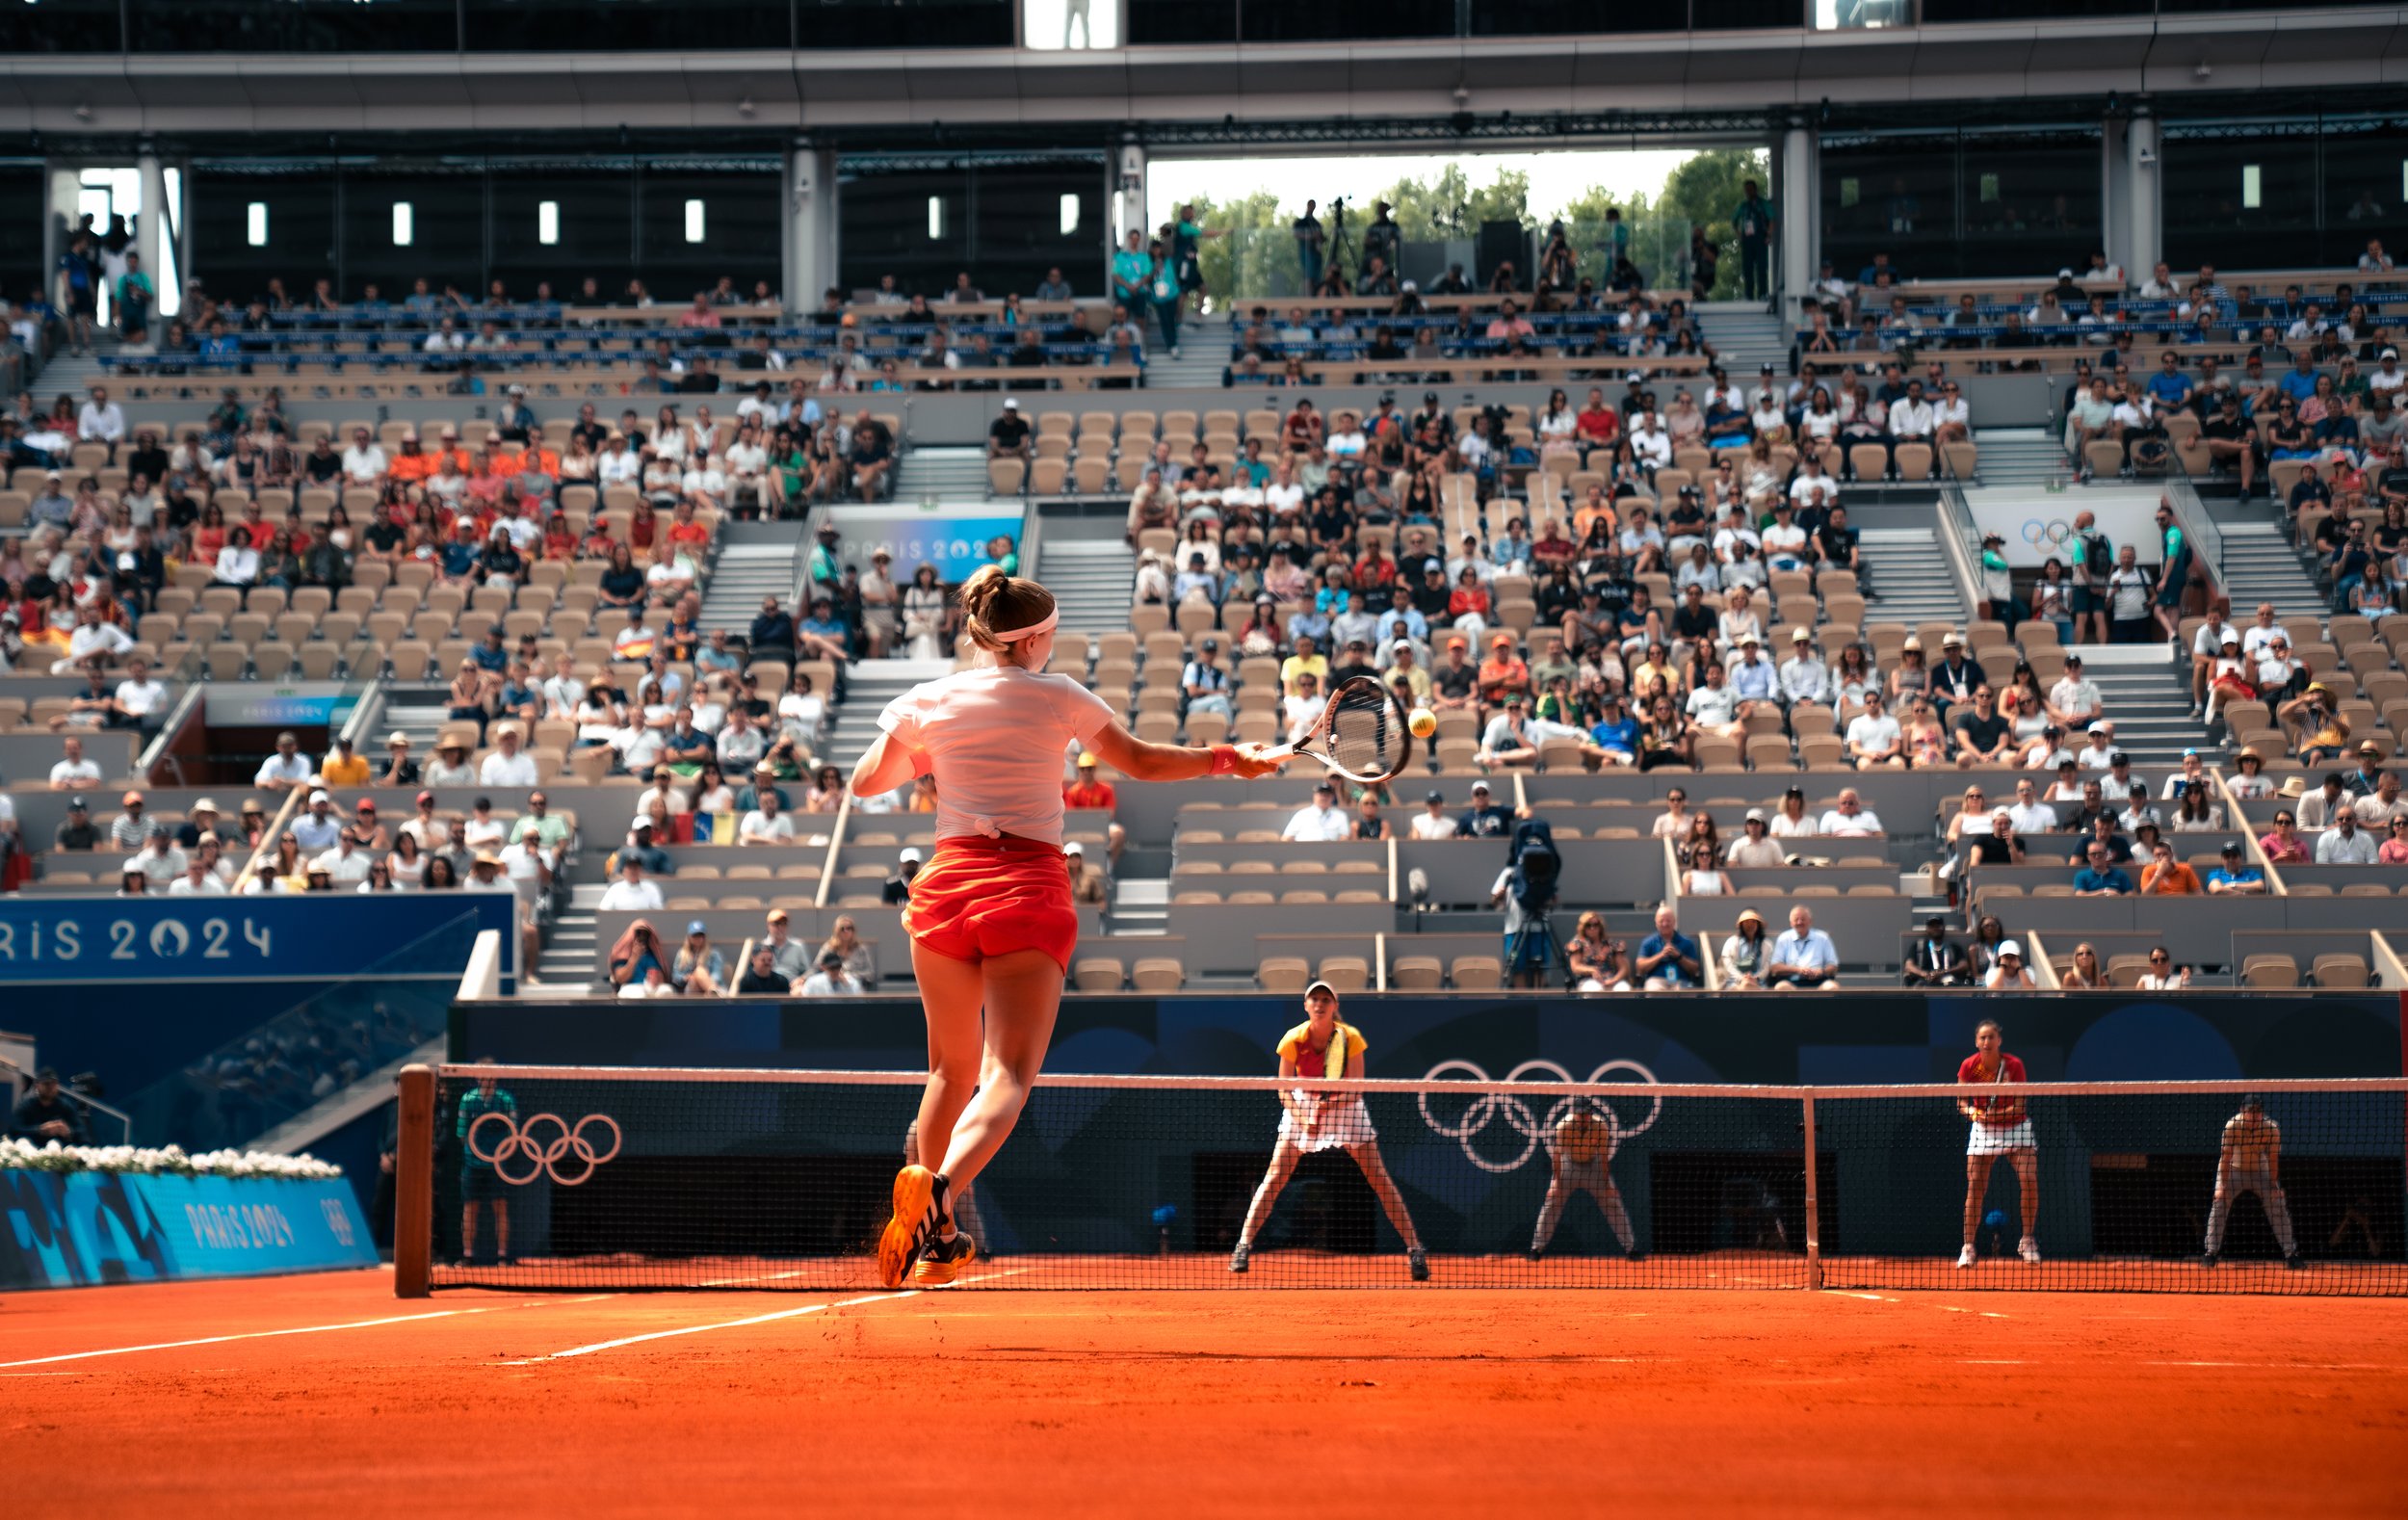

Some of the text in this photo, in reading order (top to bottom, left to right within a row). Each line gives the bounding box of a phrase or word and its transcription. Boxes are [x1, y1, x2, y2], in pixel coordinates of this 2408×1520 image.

[932, 538, 987, 560] 202
[110, 918, 271, 960] 2024
[241, 1203, 295, 1248] 2024
